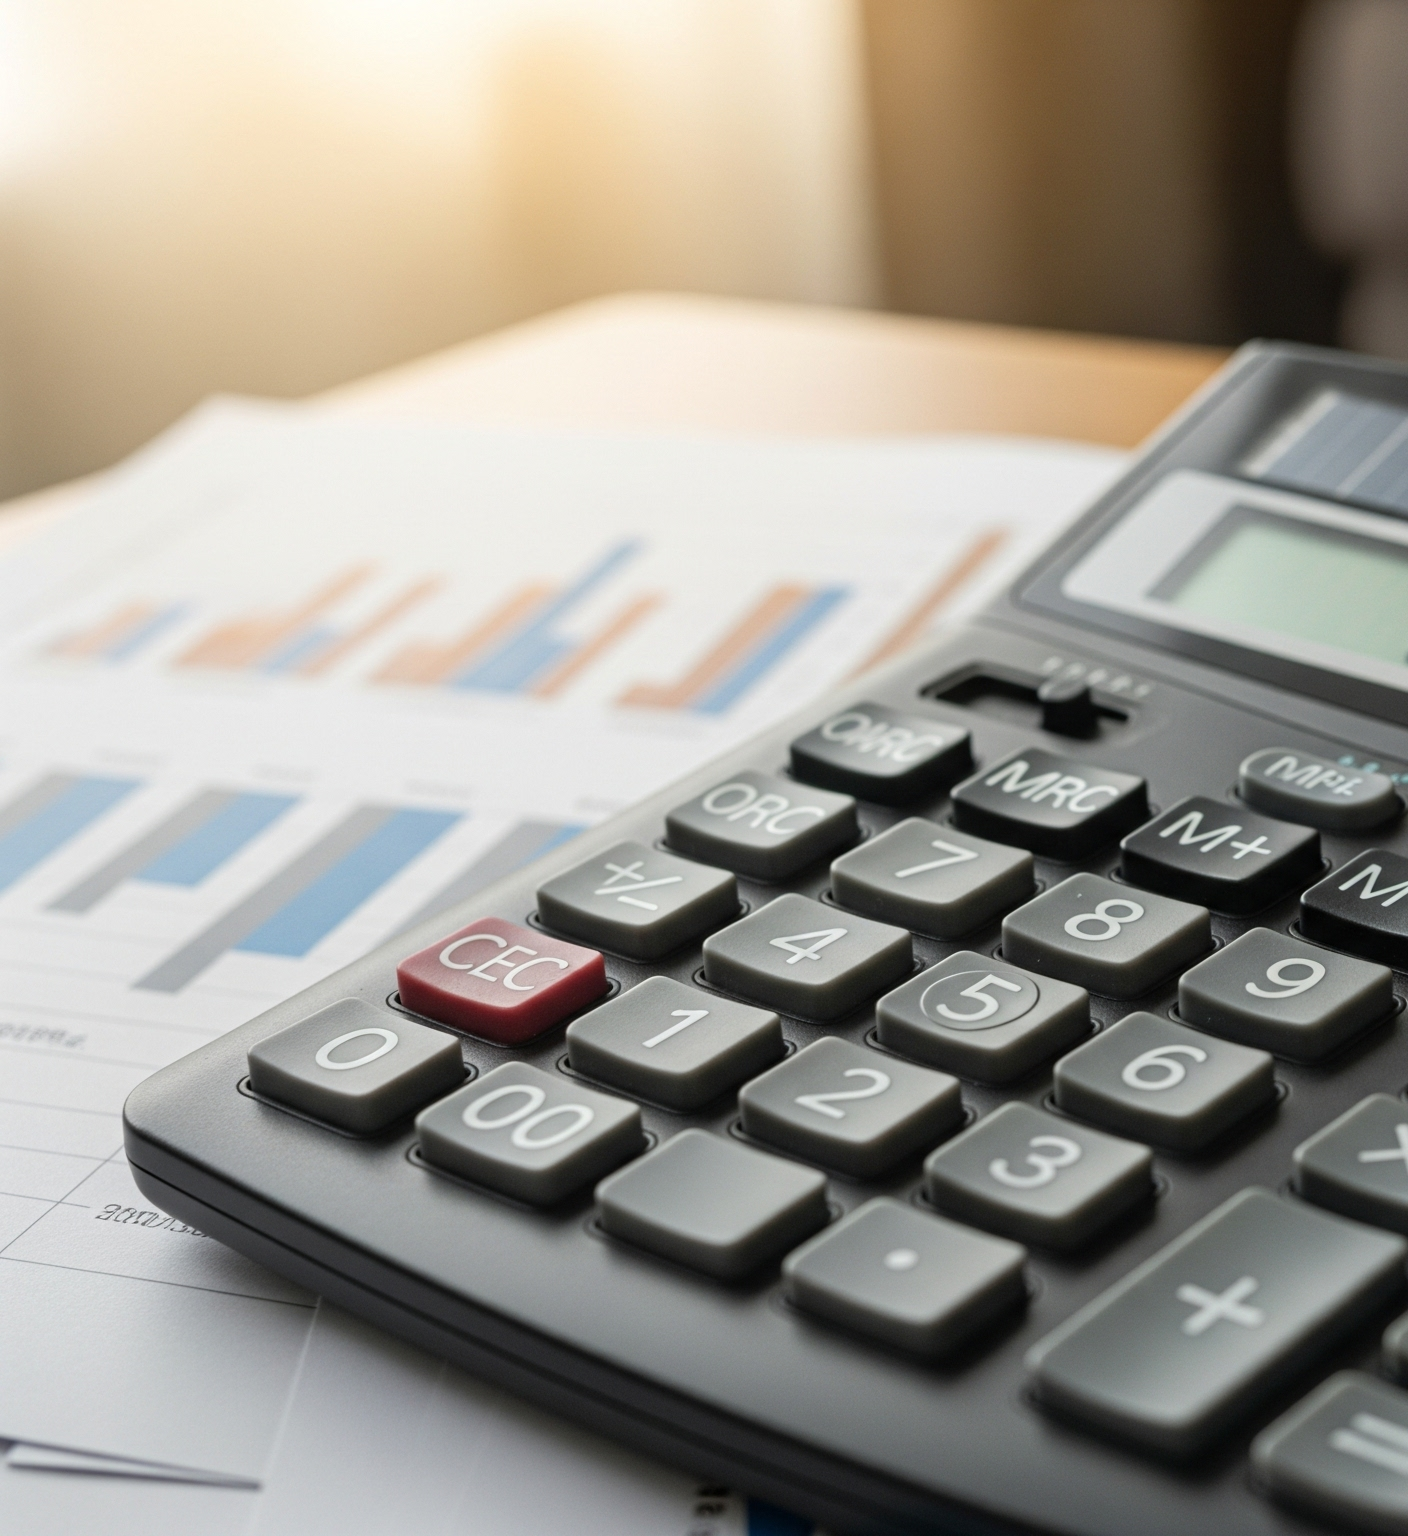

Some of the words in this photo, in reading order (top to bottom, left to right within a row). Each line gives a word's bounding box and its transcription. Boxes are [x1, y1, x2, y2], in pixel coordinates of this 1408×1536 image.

[702, 783, 826, 834] ORC
[985, 760, 1119, 813] MRC
[895, 840, 979, 878] 7
[1158, 811, 1272, 860] M+
[1064, 898, 1145, 941] 8
[439, 934, 568, 991] CEC
[770, 927, 848, 965] 4
[936, 973, 1021, 1022] 5
[1245, 957, 1326, 998] 9
[315, 1027, 398, 1071] 0
[642, 1009, 709, 1048] 1
[1121, 1044, 1207, 1091] 6
[462, 1084, 594, 1149] 00
[795, 1067, 891, 1119] 2
[989, 1136, 1082, 1188] 3
